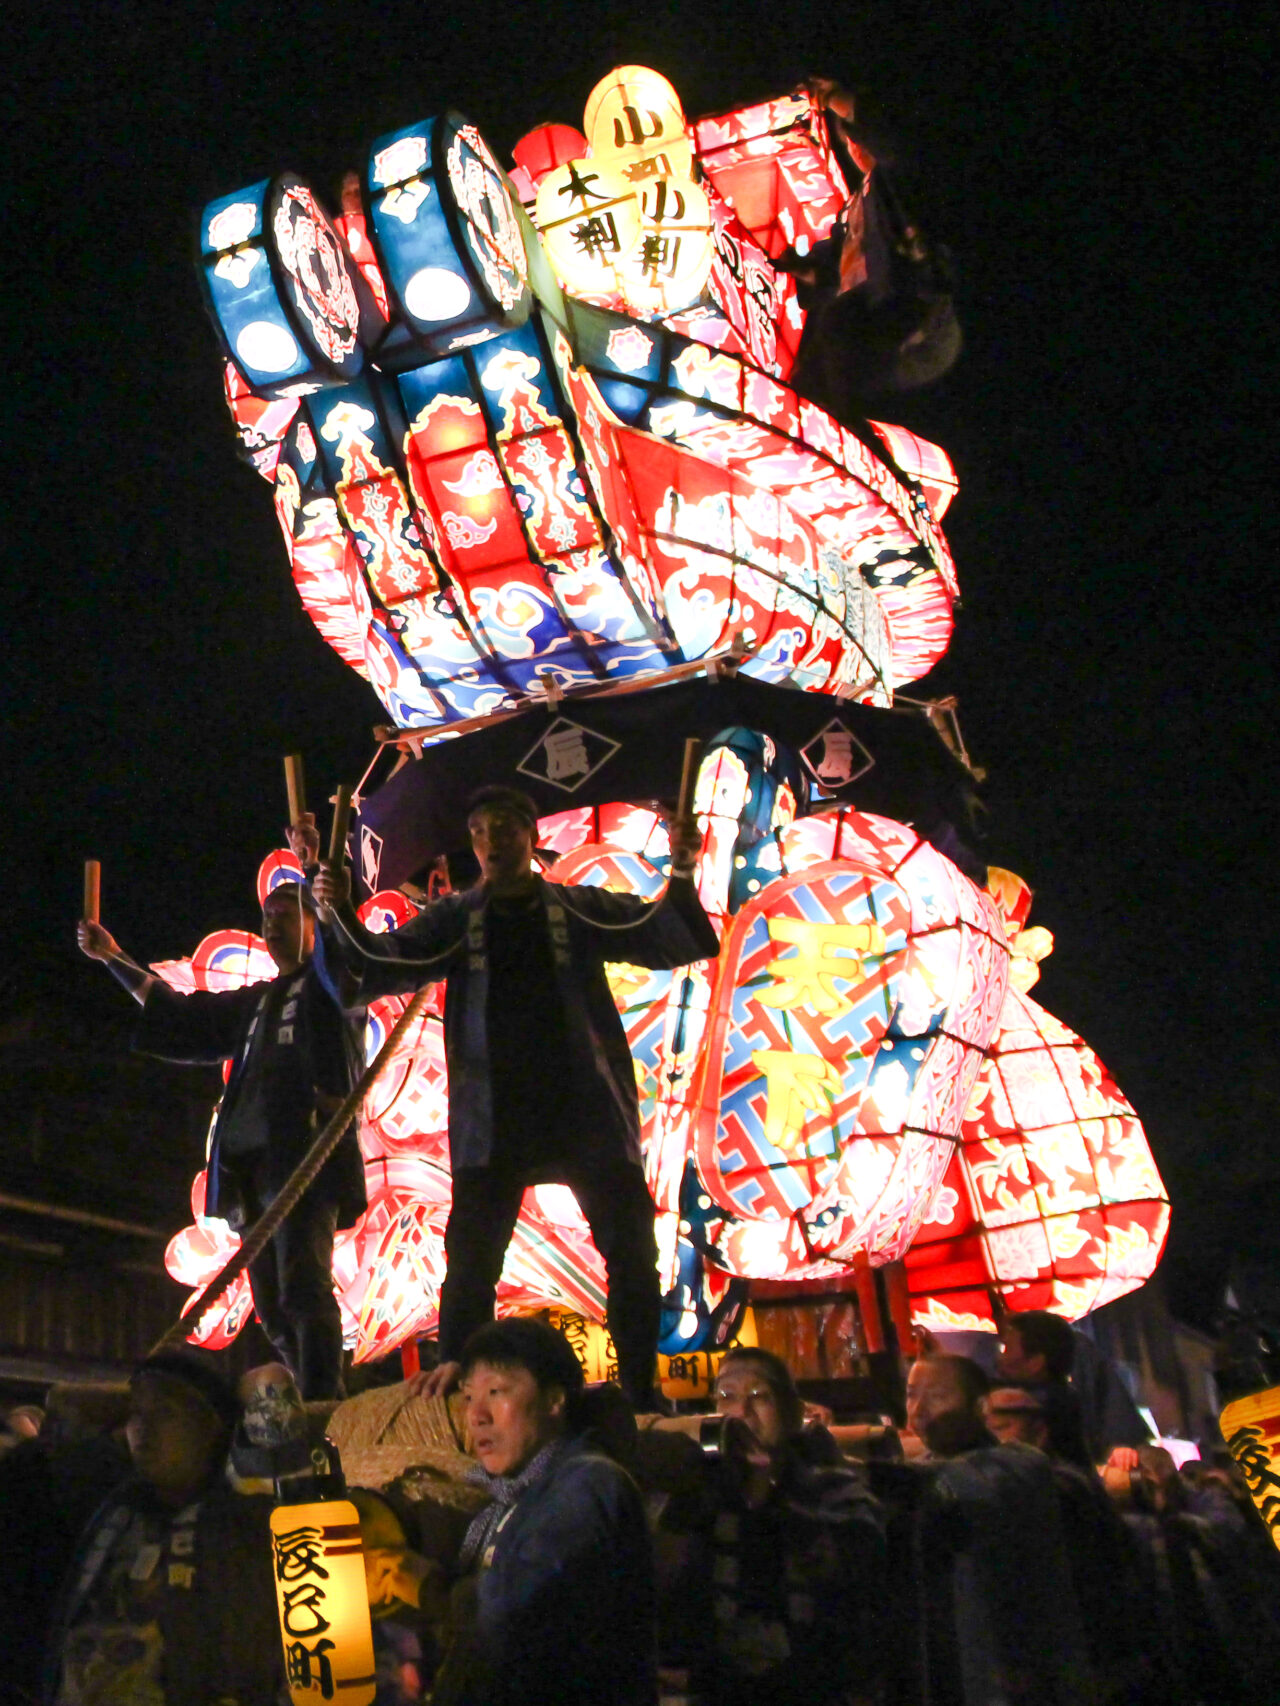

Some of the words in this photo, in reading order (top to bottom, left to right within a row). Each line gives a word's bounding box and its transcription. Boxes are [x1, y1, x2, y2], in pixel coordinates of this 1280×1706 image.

[752, 917, 887, 1151] 天下
[272, 1526, 336, 1700] 辰巳町
